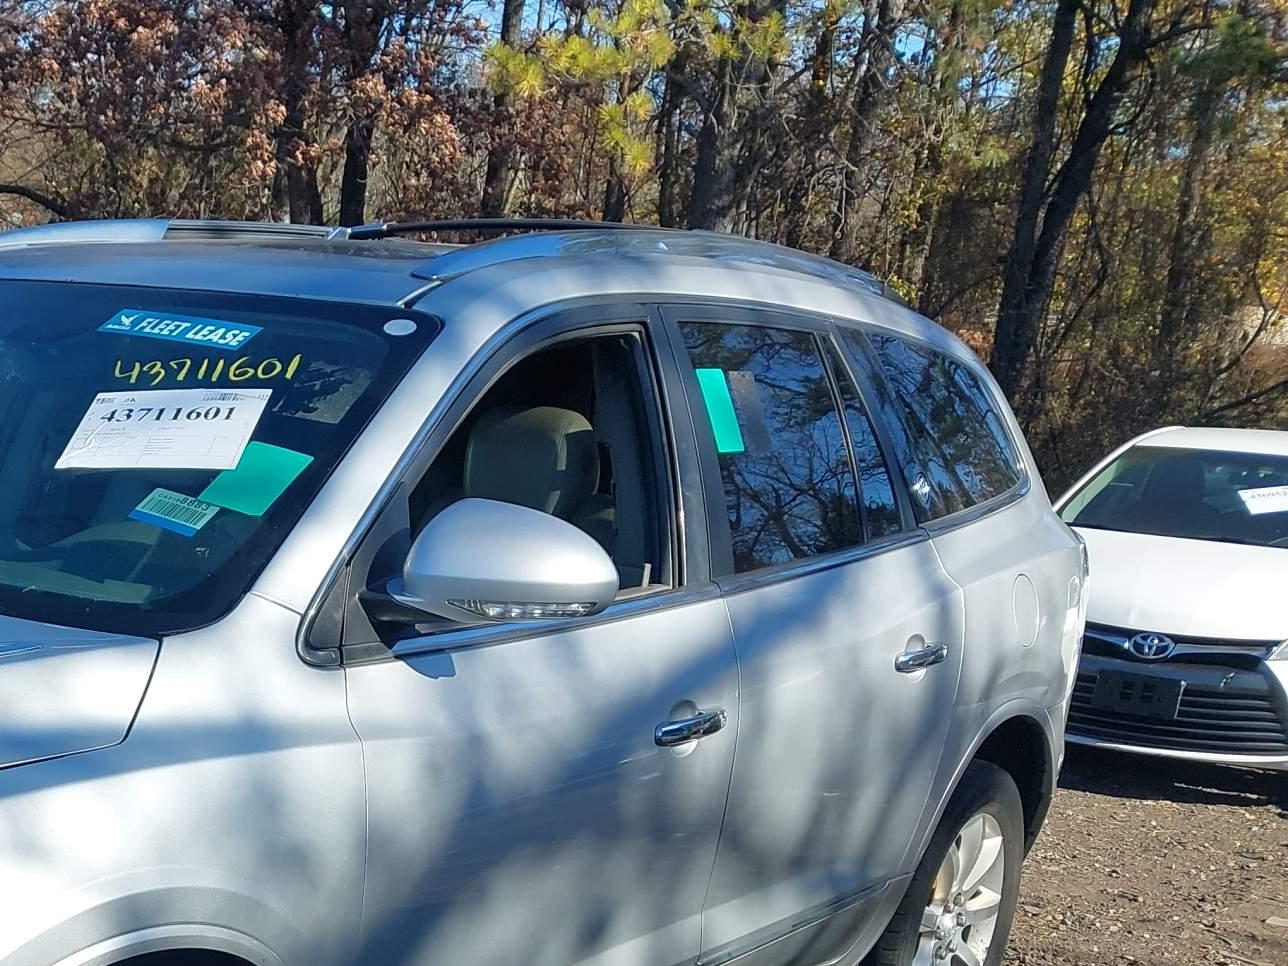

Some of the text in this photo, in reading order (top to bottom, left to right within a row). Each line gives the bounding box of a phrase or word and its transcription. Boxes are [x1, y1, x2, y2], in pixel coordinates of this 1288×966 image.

[134, 318, 251, 346] FLEET LEASE
[114, 353, 303, 386] 43711601
[100, 406, 237, 423] 43711601
